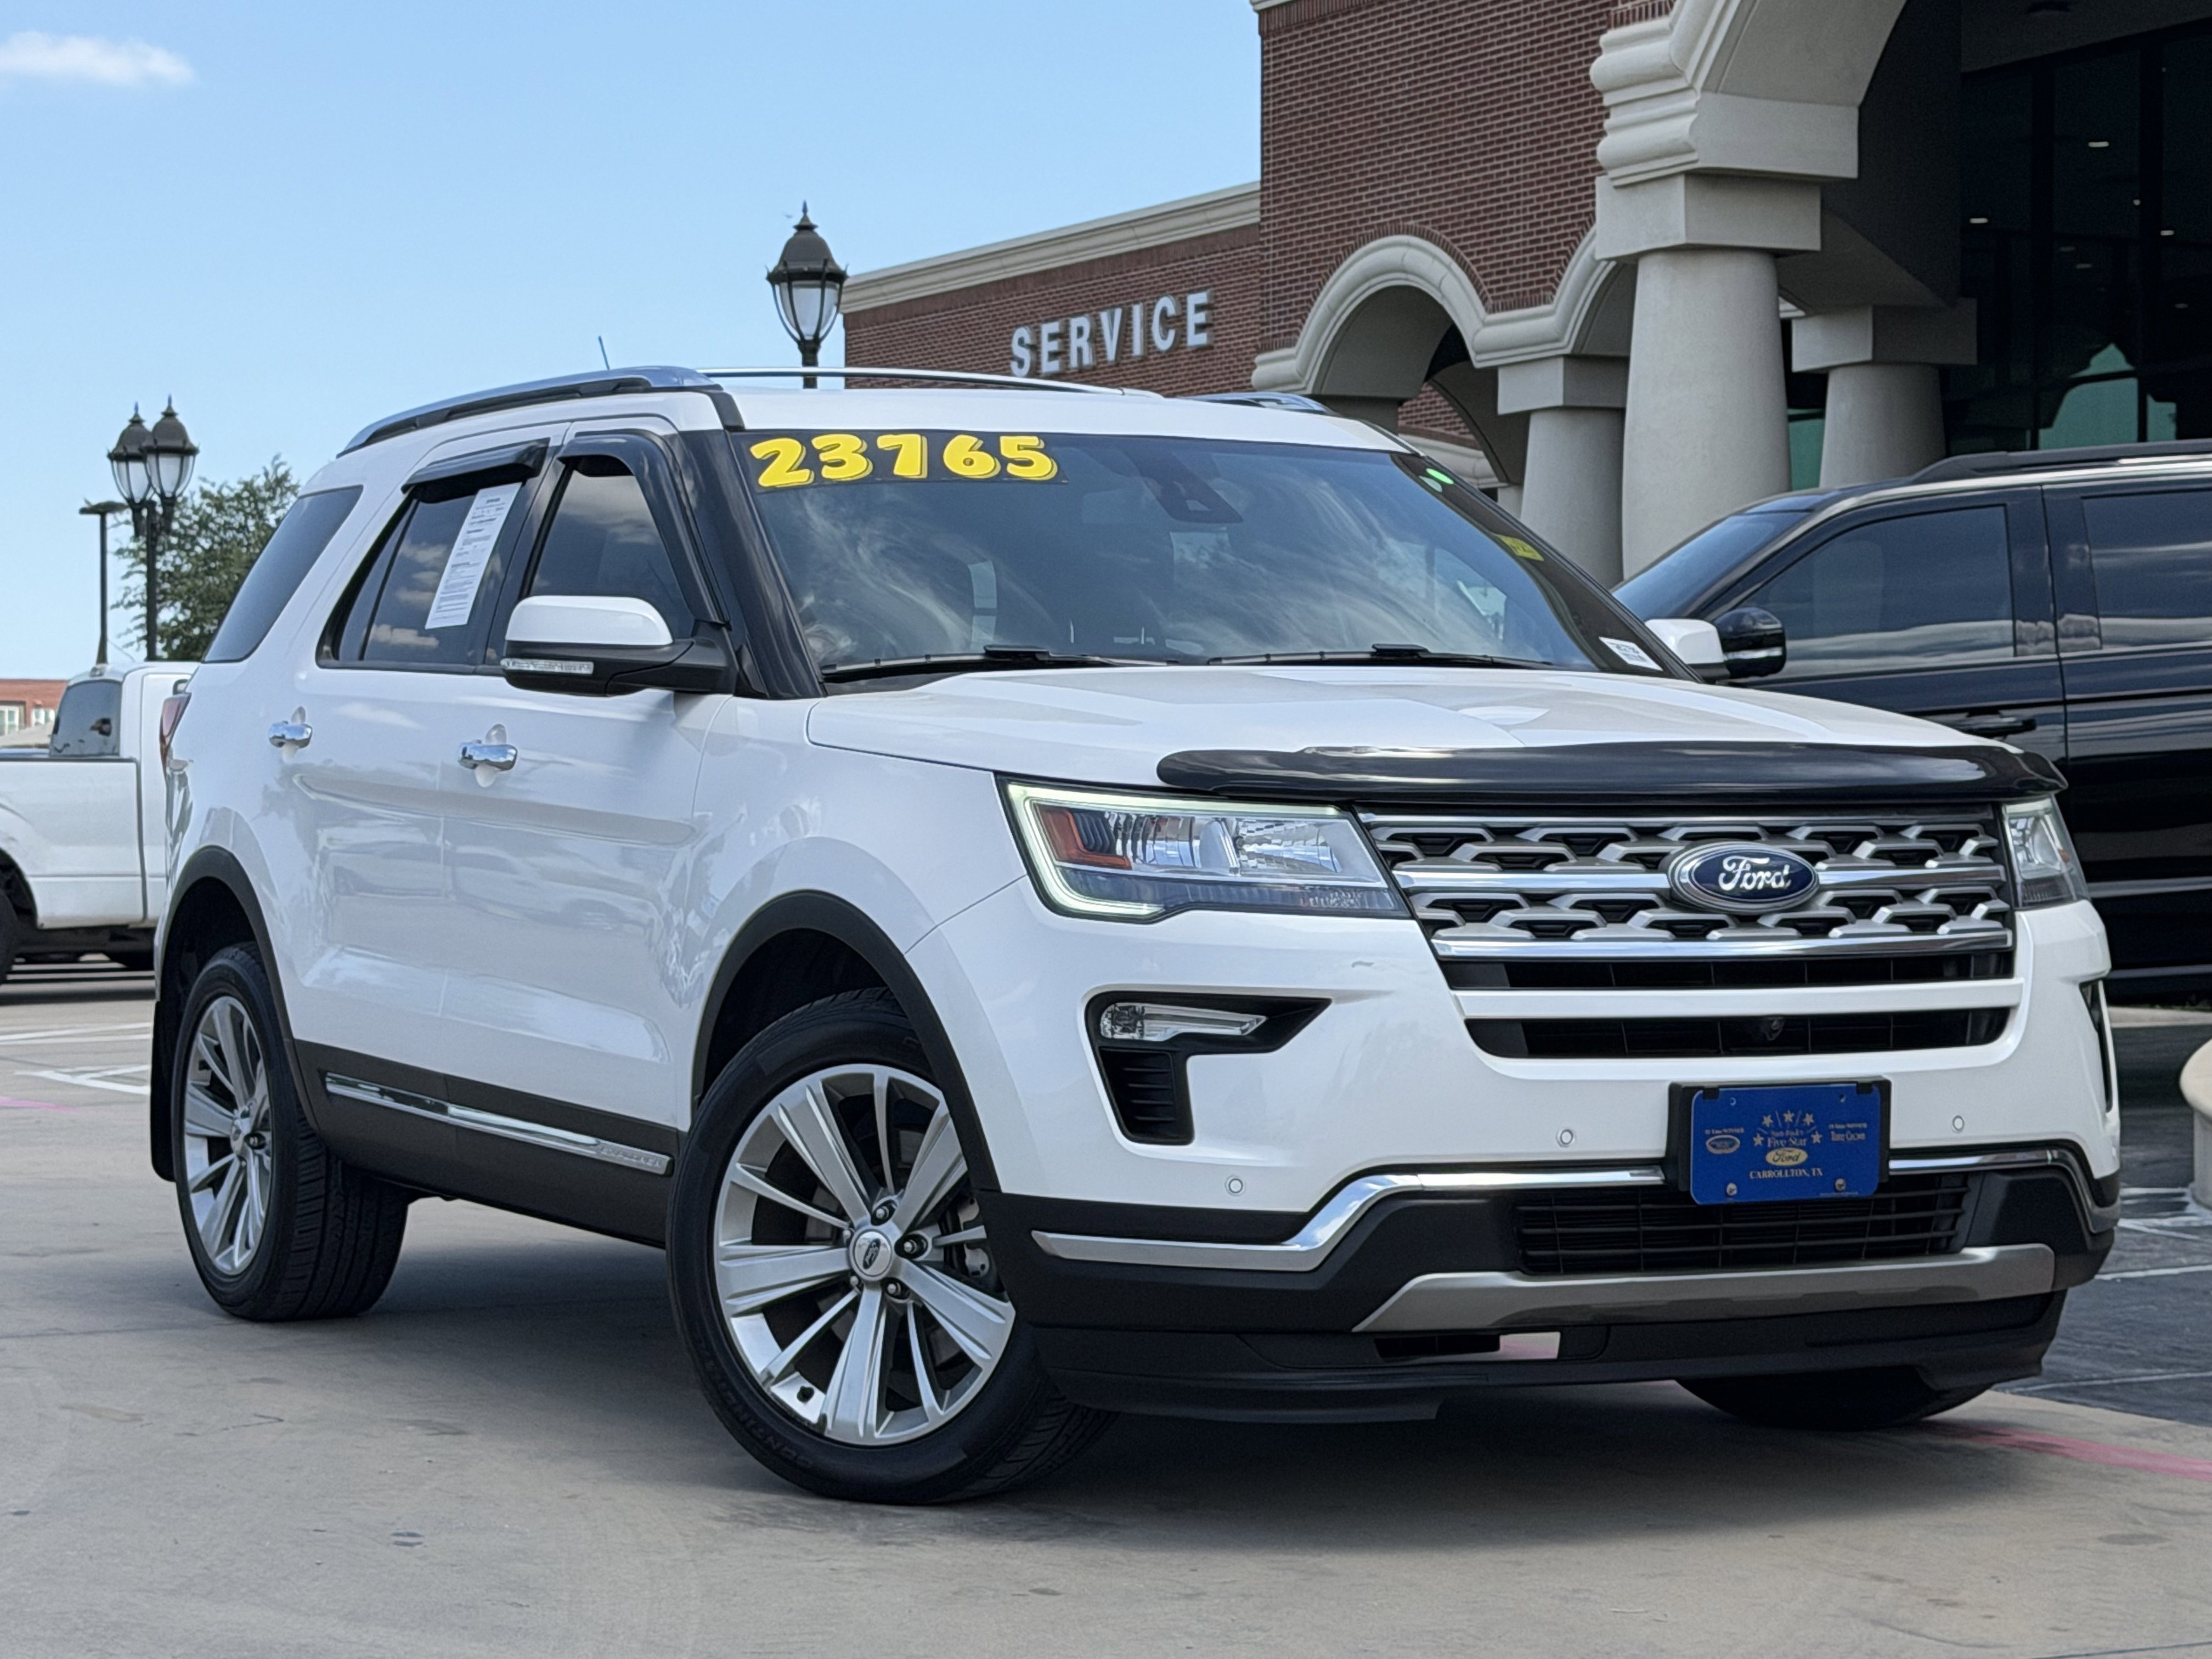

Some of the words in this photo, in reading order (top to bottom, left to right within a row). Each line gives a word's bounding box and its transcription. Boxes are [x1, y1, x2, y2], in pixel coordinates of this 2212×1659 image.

[1011, 290, 1213, 377] SERVICE
[749, 433, 1058, 488] 23765
[1718, 855, 1792, 890] Ford
[1772, 1149, 1802, 1163] Ford
[1812, 1167, 1824, 1178] TX
